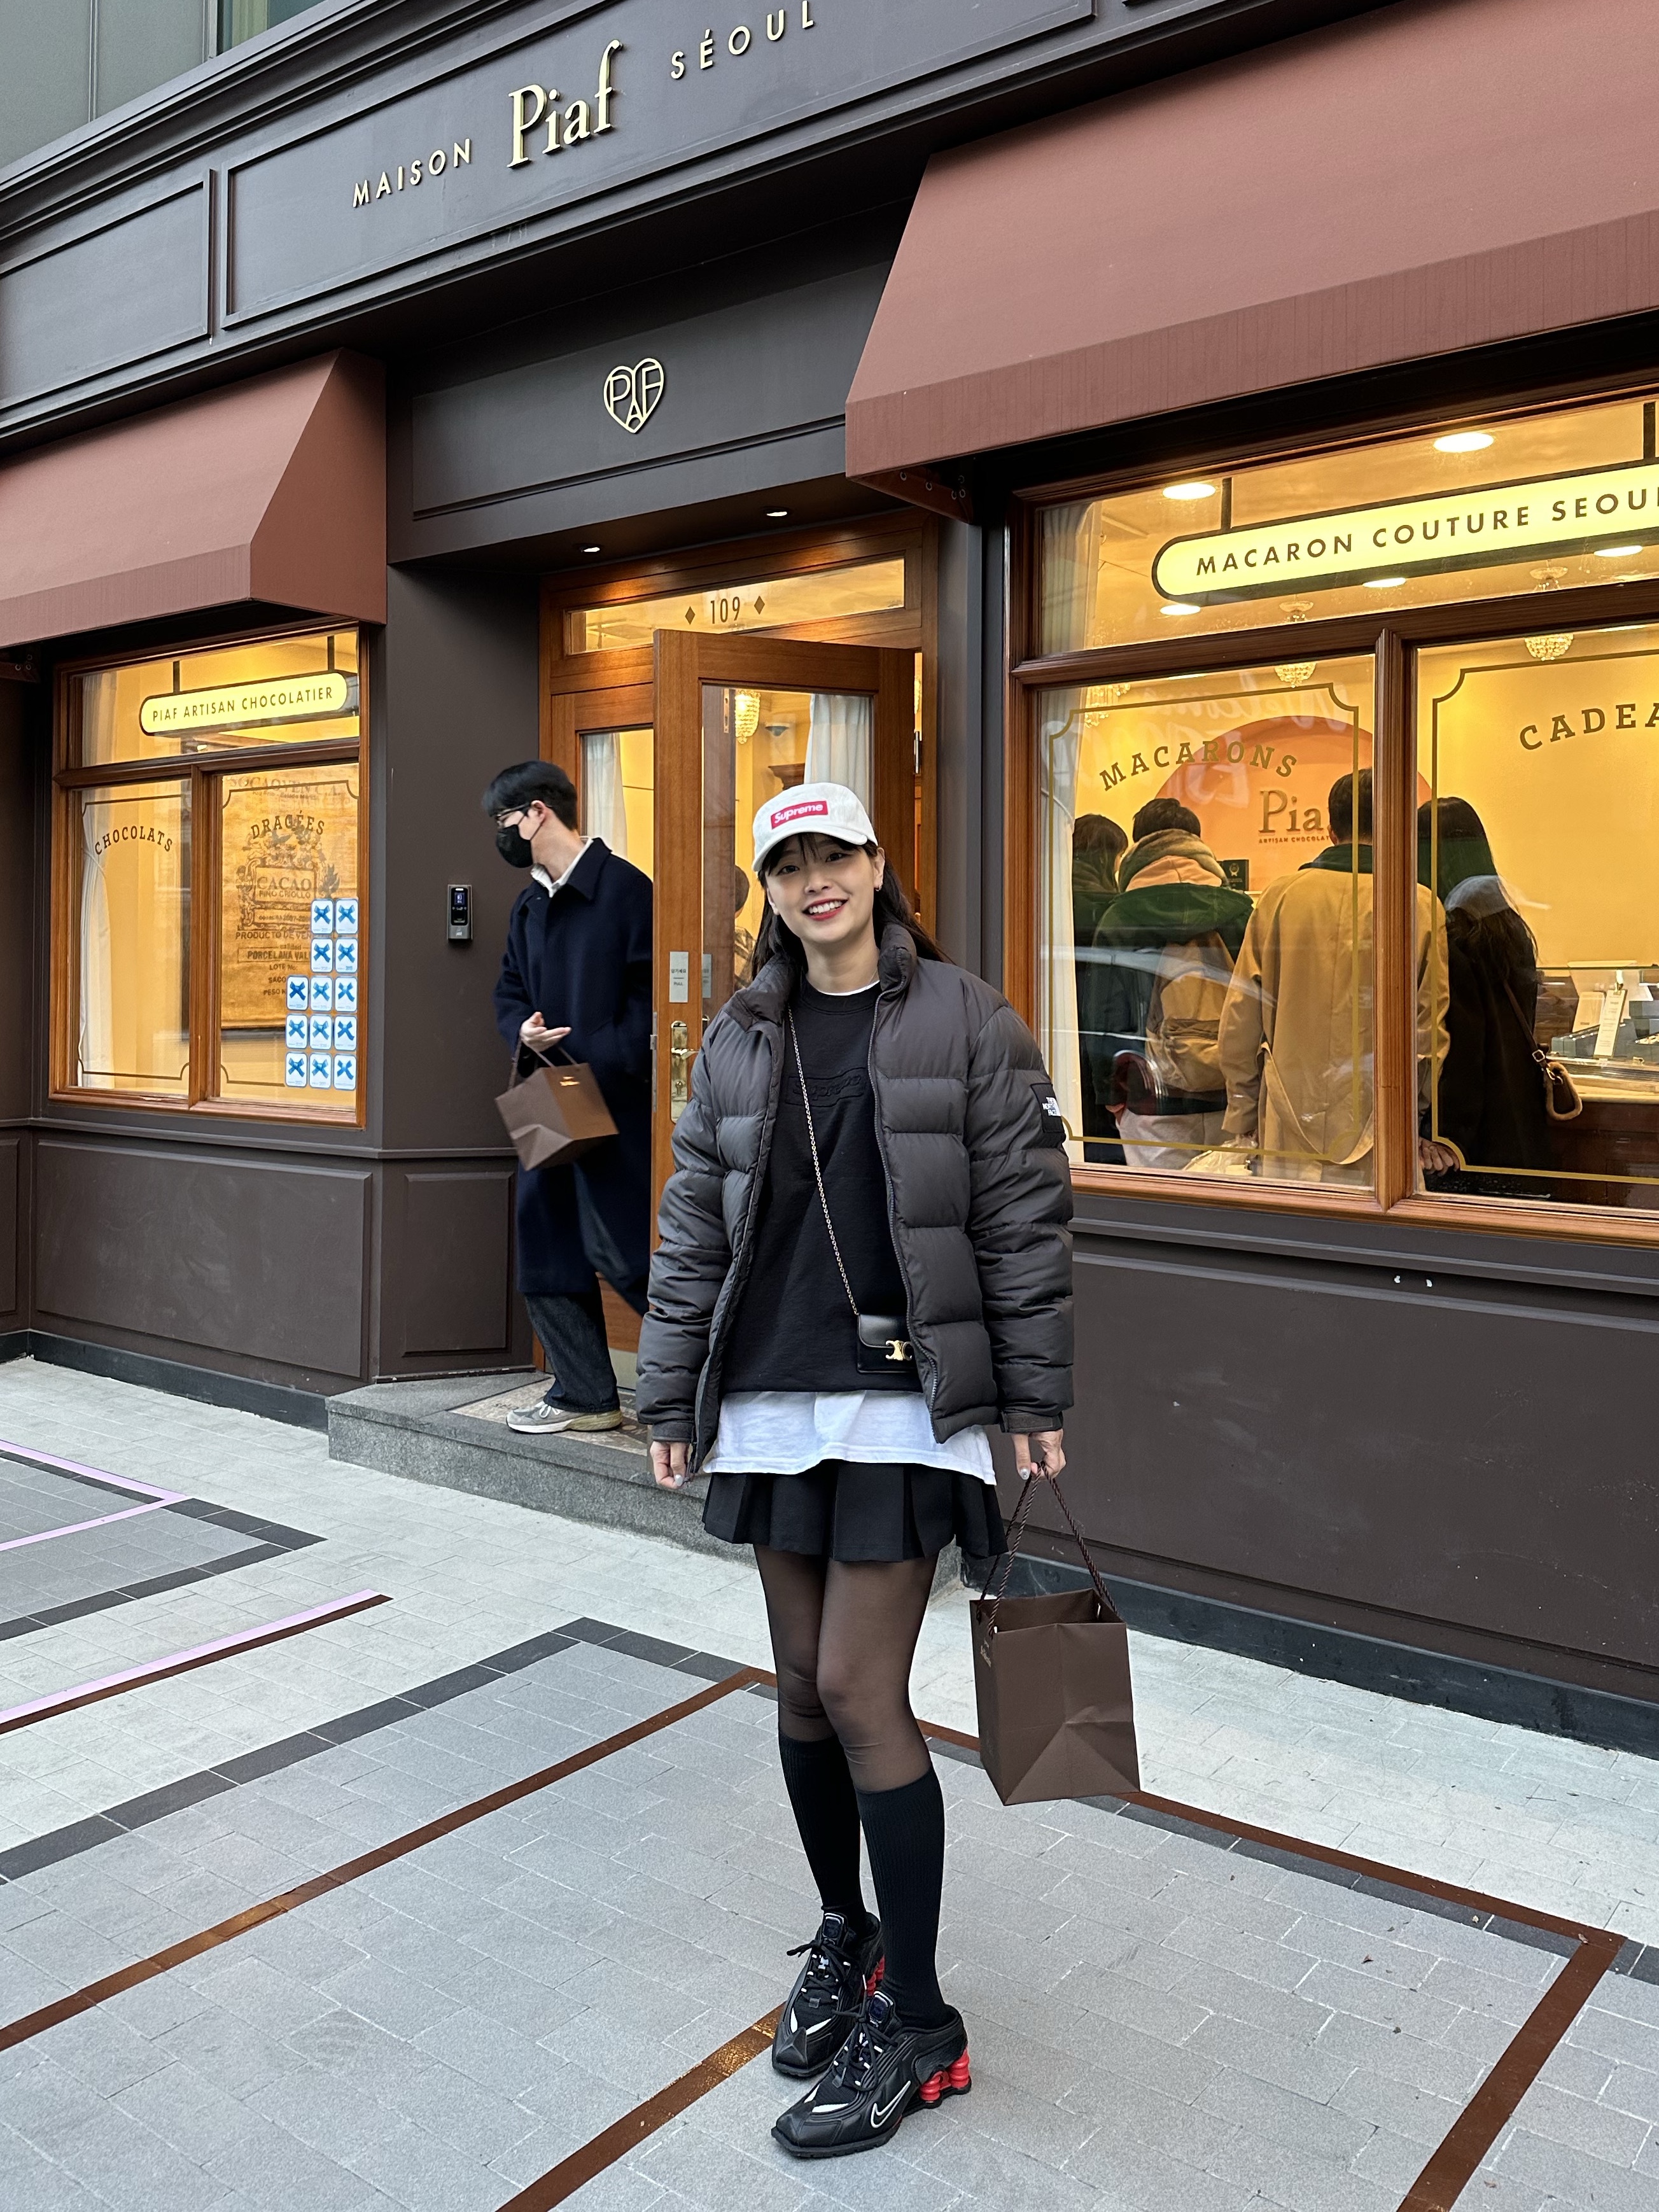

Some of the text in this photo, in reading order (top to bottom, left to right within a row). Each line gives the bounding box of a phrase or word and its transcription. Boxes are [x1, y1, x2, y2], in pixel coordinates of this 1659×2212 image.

[353, 0, 815, 207] MAISON Piaf SÉOUL
[1196, 487, 1659, 576] MACARON COUTURE SEOU
[711, 596, 740, 624] 109
[153, 686, 332, 722] PIAF ARTISAN CHOCOLATIER
[1100, 741, 1297, 792] MACARONS
[251, 810, 325, 839] DRAGÉES
[774, 804, 823, 824] Supreme
[1258, 790, 1324, 833] Pia
[95, 825, 172, 855] CHOCOLATS
[256, 876, 312, 890] CACAO
[235, 931, 282, 939] PRODUCTO
